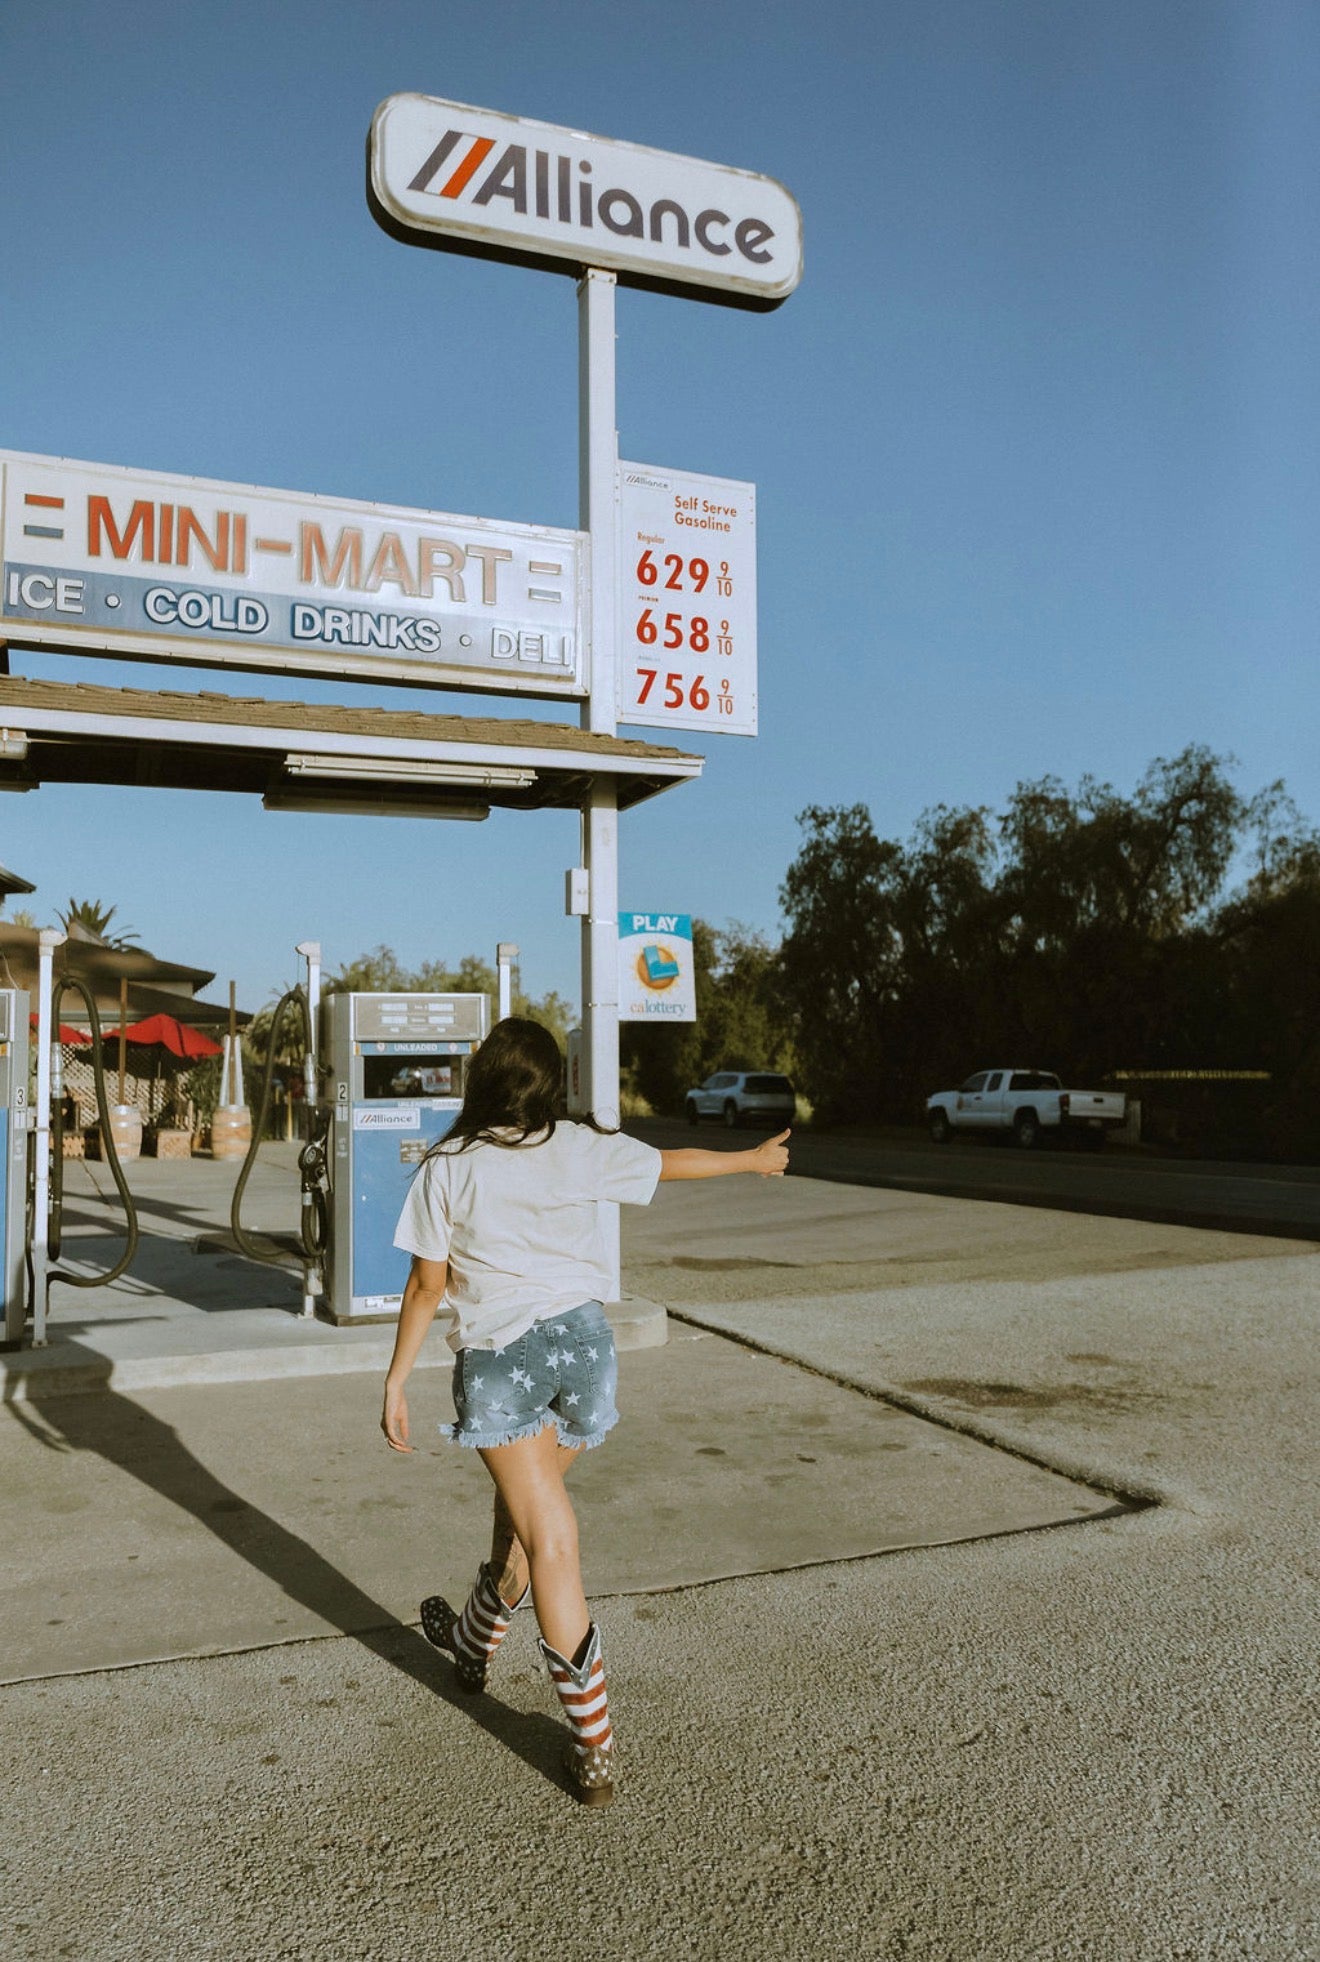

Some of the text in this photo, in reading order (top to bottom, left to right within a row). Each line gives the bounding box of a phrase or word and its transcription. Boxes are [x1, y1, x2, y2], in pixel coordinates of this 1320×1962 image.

[471, 144, 775, 264] Alliance
[675, 495, 737, 517] Self Serve
[674, 511, 731, 533] Gasoline
[637, 531, 665, 544] Regular
[87, 494, 513, 605] MINI-MART
[636, 549, 710, 594] 629
[8, 571, 571, 667] ICE COLD DRINKS DELI
[636, 608, 710, 653] 658
[636, 667, 710, 712] 756
[633, 914, 679, 933] PLAY
[630, 999, 686, 1021] calottery
[393, 1043, 438, 1052] UNLEADED
[17, 1088, 24, 1106] 3
[339, 1084, 346, 1100] 2
[370, 1115, 413, 1124] Alliance
